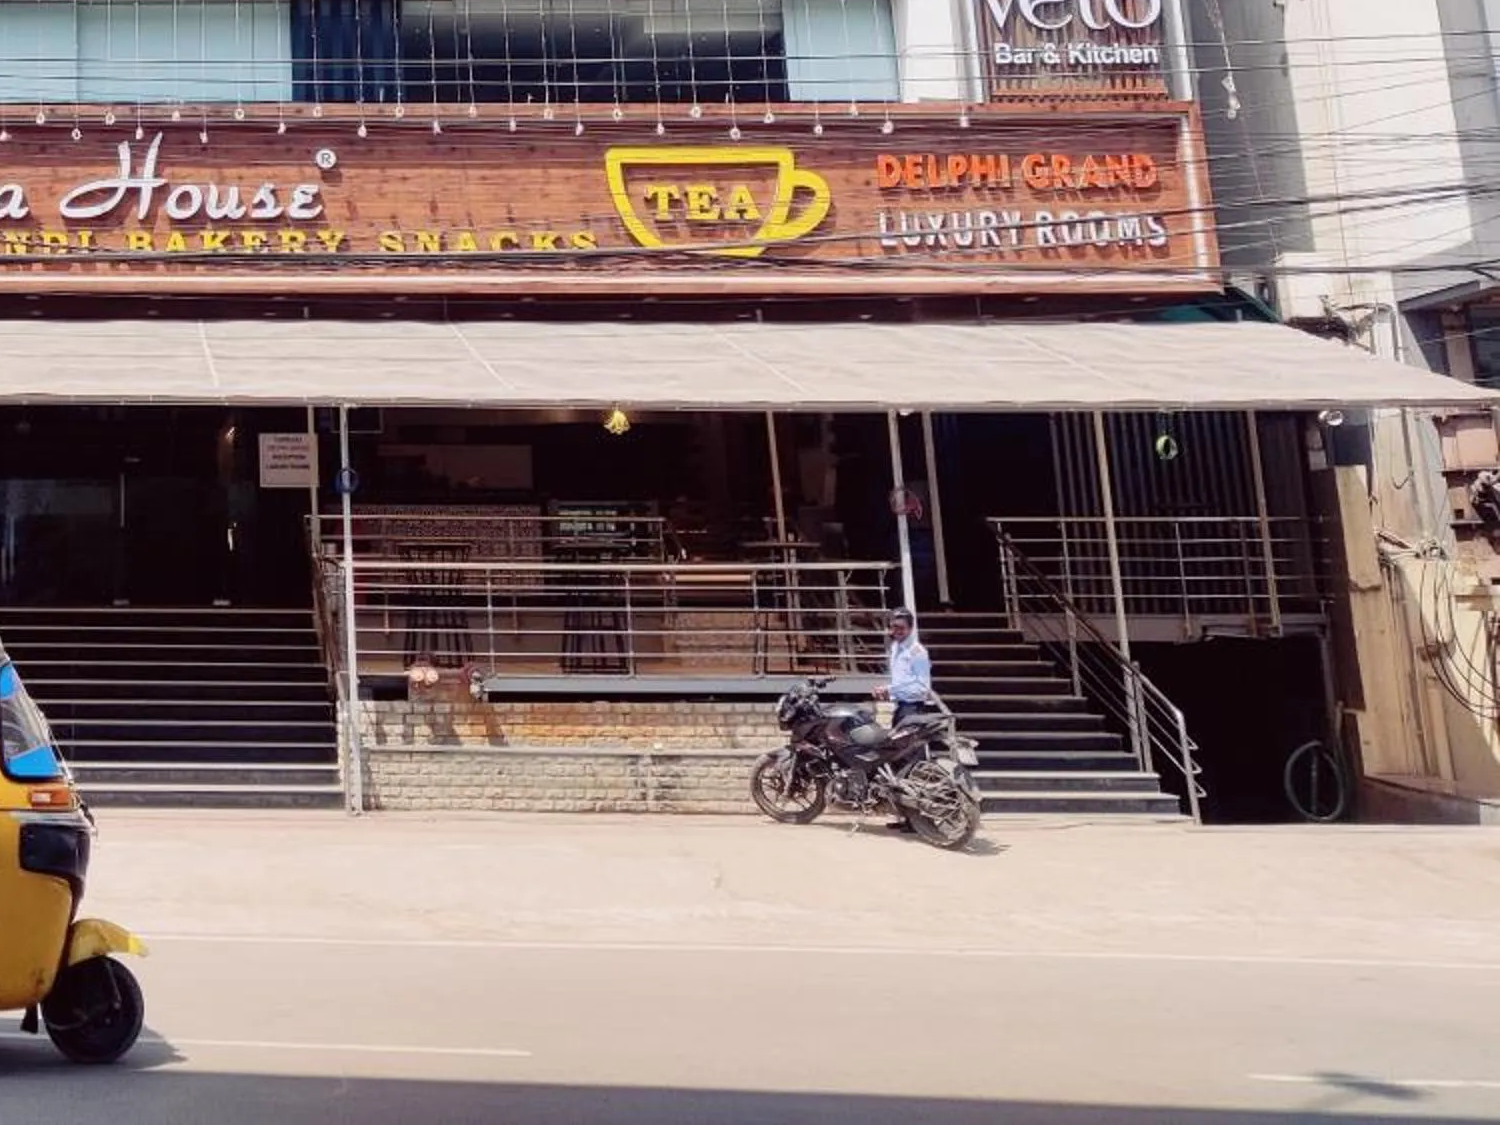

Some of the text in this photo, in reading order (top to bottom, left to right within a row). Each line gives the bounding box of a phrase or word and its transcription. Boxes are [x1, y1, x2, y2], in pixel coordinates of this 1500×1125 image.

[995, 43, 1034, 64] Bar
[1068, 43, 1159, 64] Kitchen
[59, 131, 323, 220] House
[877, 154, 1159, 189] DELPHI GRAND
[646, 185, 764, 220] TEA
[129, 230, 346, 253] BAKERY
[380, 231, 599, 252] SNACKS
[879, 209, 1168, 247] LUXURY ROOMS
